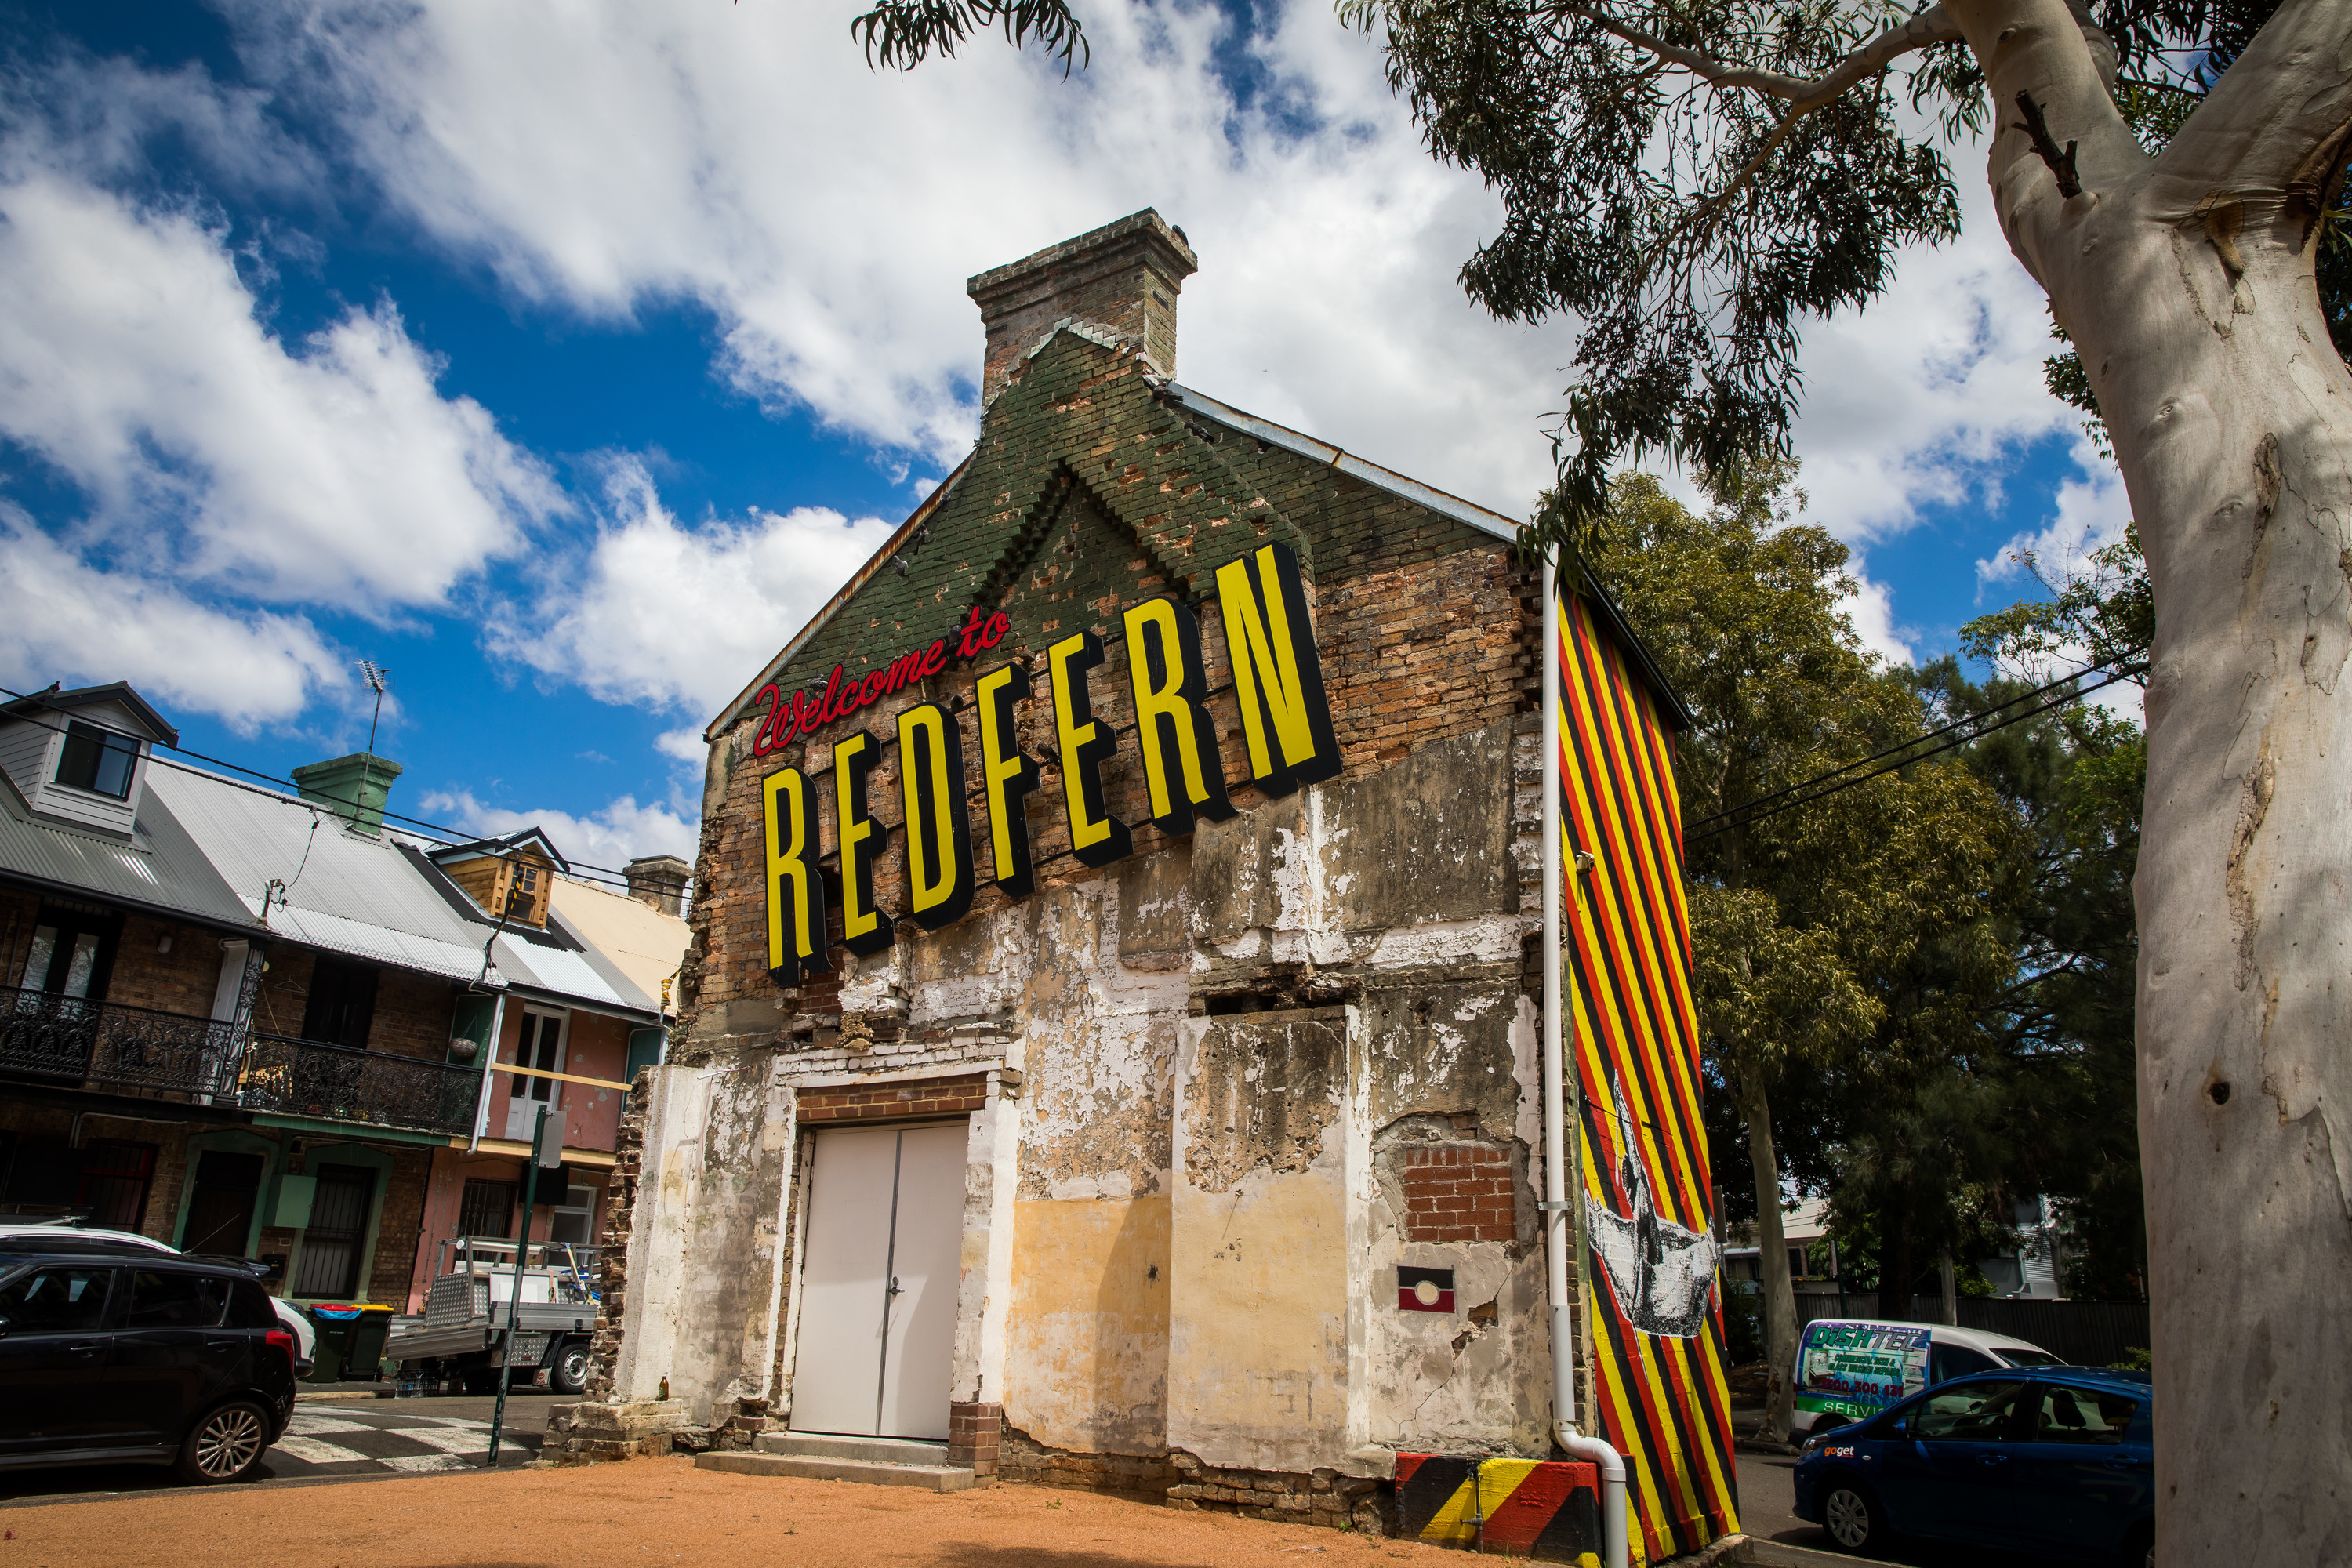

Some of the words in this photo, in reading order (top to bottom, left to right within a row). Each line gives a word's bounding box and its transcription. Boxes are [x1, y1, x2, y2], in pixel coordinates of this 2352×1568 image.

[753, 638, 949, 757] Welcome
[956, 605, 1012, 658] to
[762, 540, 1343, 988] REDFERN
[1835, 1353, 1873, 1365] COMMERCIAL
[1873, 1356, 1890, 1366] DISH
[1889, 1358, 1896, 1367] &
[1821, 1378, 1849, 1392] 1300
[1854, 1381, 1878, 1395] 300
[1884, 1384, 1904, 1398] 131
[1824, 1446, 1855, 1457] goget
